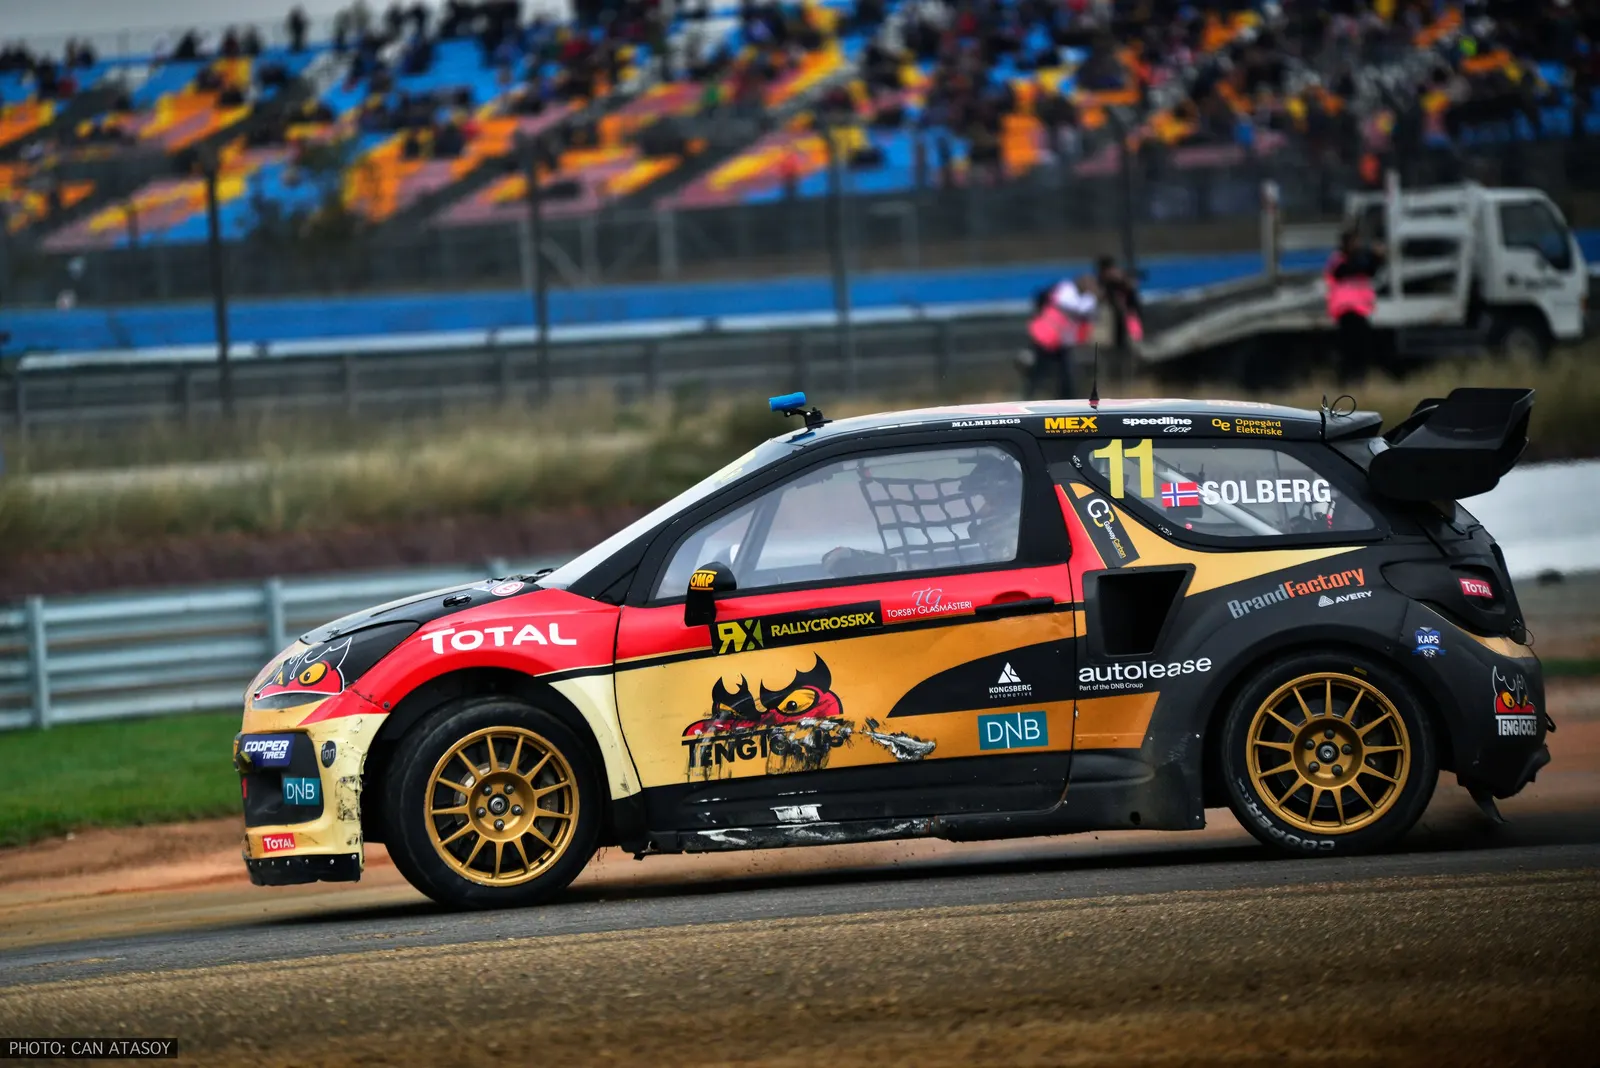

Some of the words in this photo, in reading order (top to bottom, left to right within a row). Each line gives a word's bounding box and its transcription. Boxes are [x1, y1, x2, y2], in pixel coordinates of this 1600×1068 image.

[952, 419, 1021, 428] MALMBERGS
[1044, 416, 1098, 430] MEX
[1122, 416, 1193, 426] speedline
[1235, 418, 1281, 428] Oppegård
[1163, 425, 1192, 433] Corse
[1236, 426, 1283, 436] Elektriske
[1093, 438, 1155, 499] 11
[1202, 479, 1332, 505] SOLBERG
[690, 573, 715, 587] OMP
[1227, 568, 1365, 619] BrandFactory
[1462, 581, 1492, 596] TOTAL
[911, 587, 942, 609] TG
[1335, 590, 1373, 604] AVERY
[887, 608, 916, 618] TORSBY
[917, 601, 972, 614] GLASMÄSTERI
[770, 612, 876, 637] RALLYCROSSRX
[421, 623, 577, 654] TOTAL
[1417, 635, 1439, 644] KAPS
[1079, 657, 1212, 682] autolease
[988, 684, 1032, 694] KONGSBERG
[1110, 682, 1125, 690] DNB
[1125, 682, 1143, 690] Group
[986, 711, 1040, 749] DNB
[244, 740, 289, 753] COOPER
[322, 743, 335, 760] ion
[262, 751, 286, 760] TIRES
[286, 777, 316, 805] DNB
[263, 837, 295, 850] TOTAL
